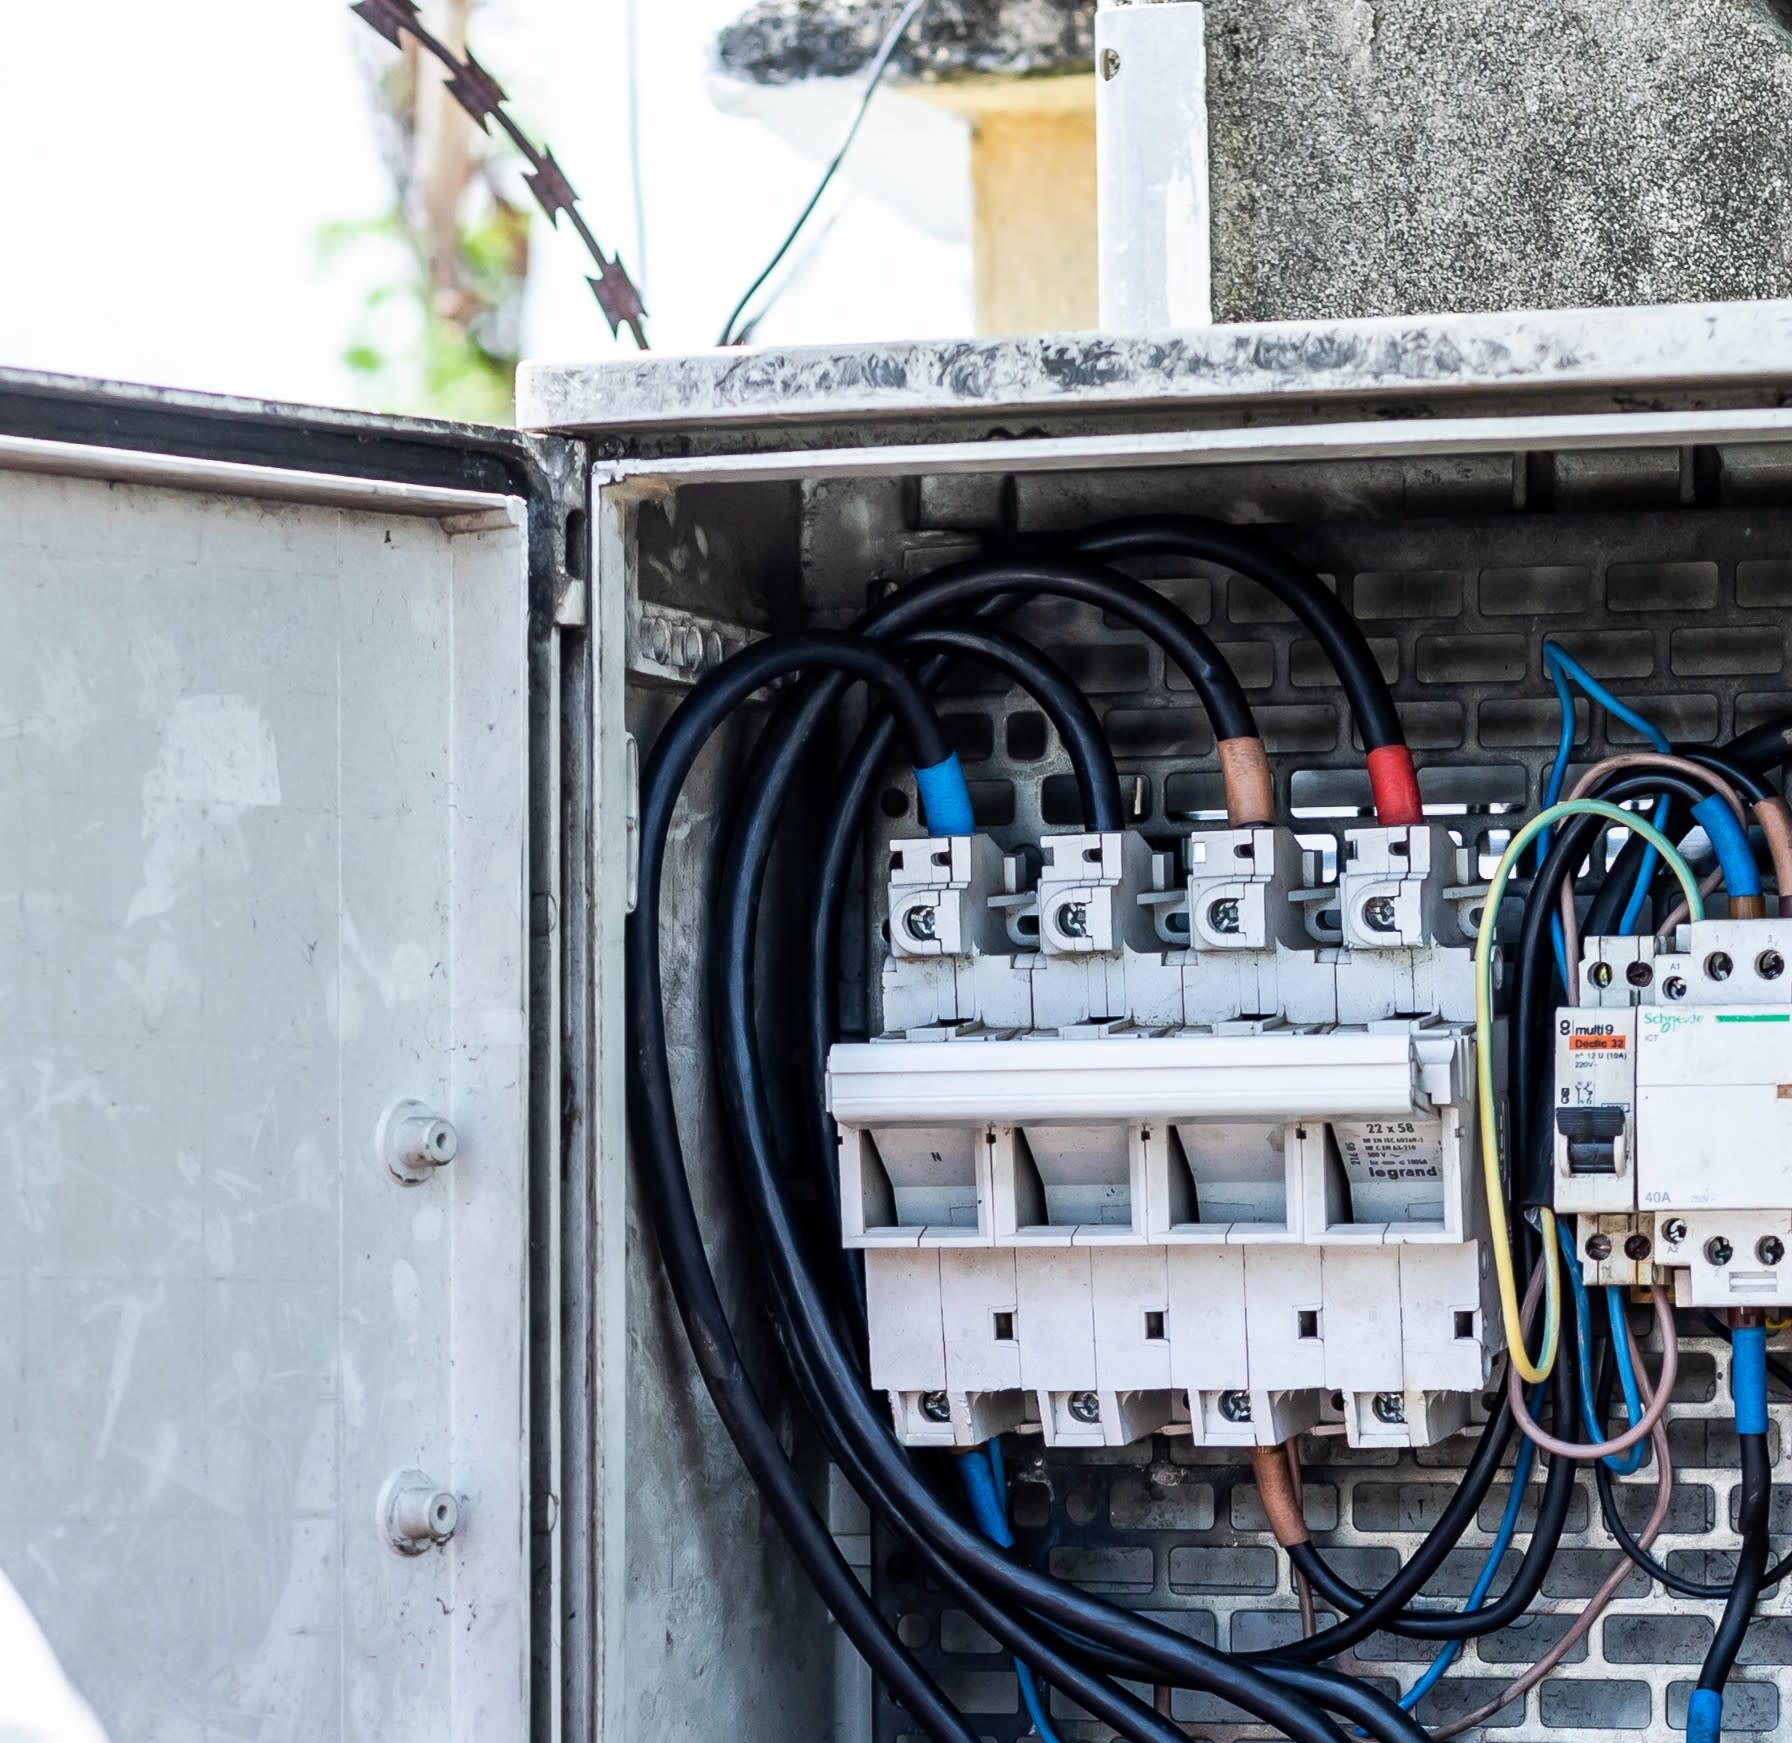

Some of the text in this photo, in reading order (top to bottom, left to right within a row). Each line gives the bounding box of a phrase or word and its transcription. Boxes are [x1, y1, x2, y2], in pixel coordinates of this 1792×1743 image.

[1366, 1123, 1383, 1133] 22
[1368, 1166, 1438, 1179] legrand
[1644, 1191, 1672, 1204] 40A
